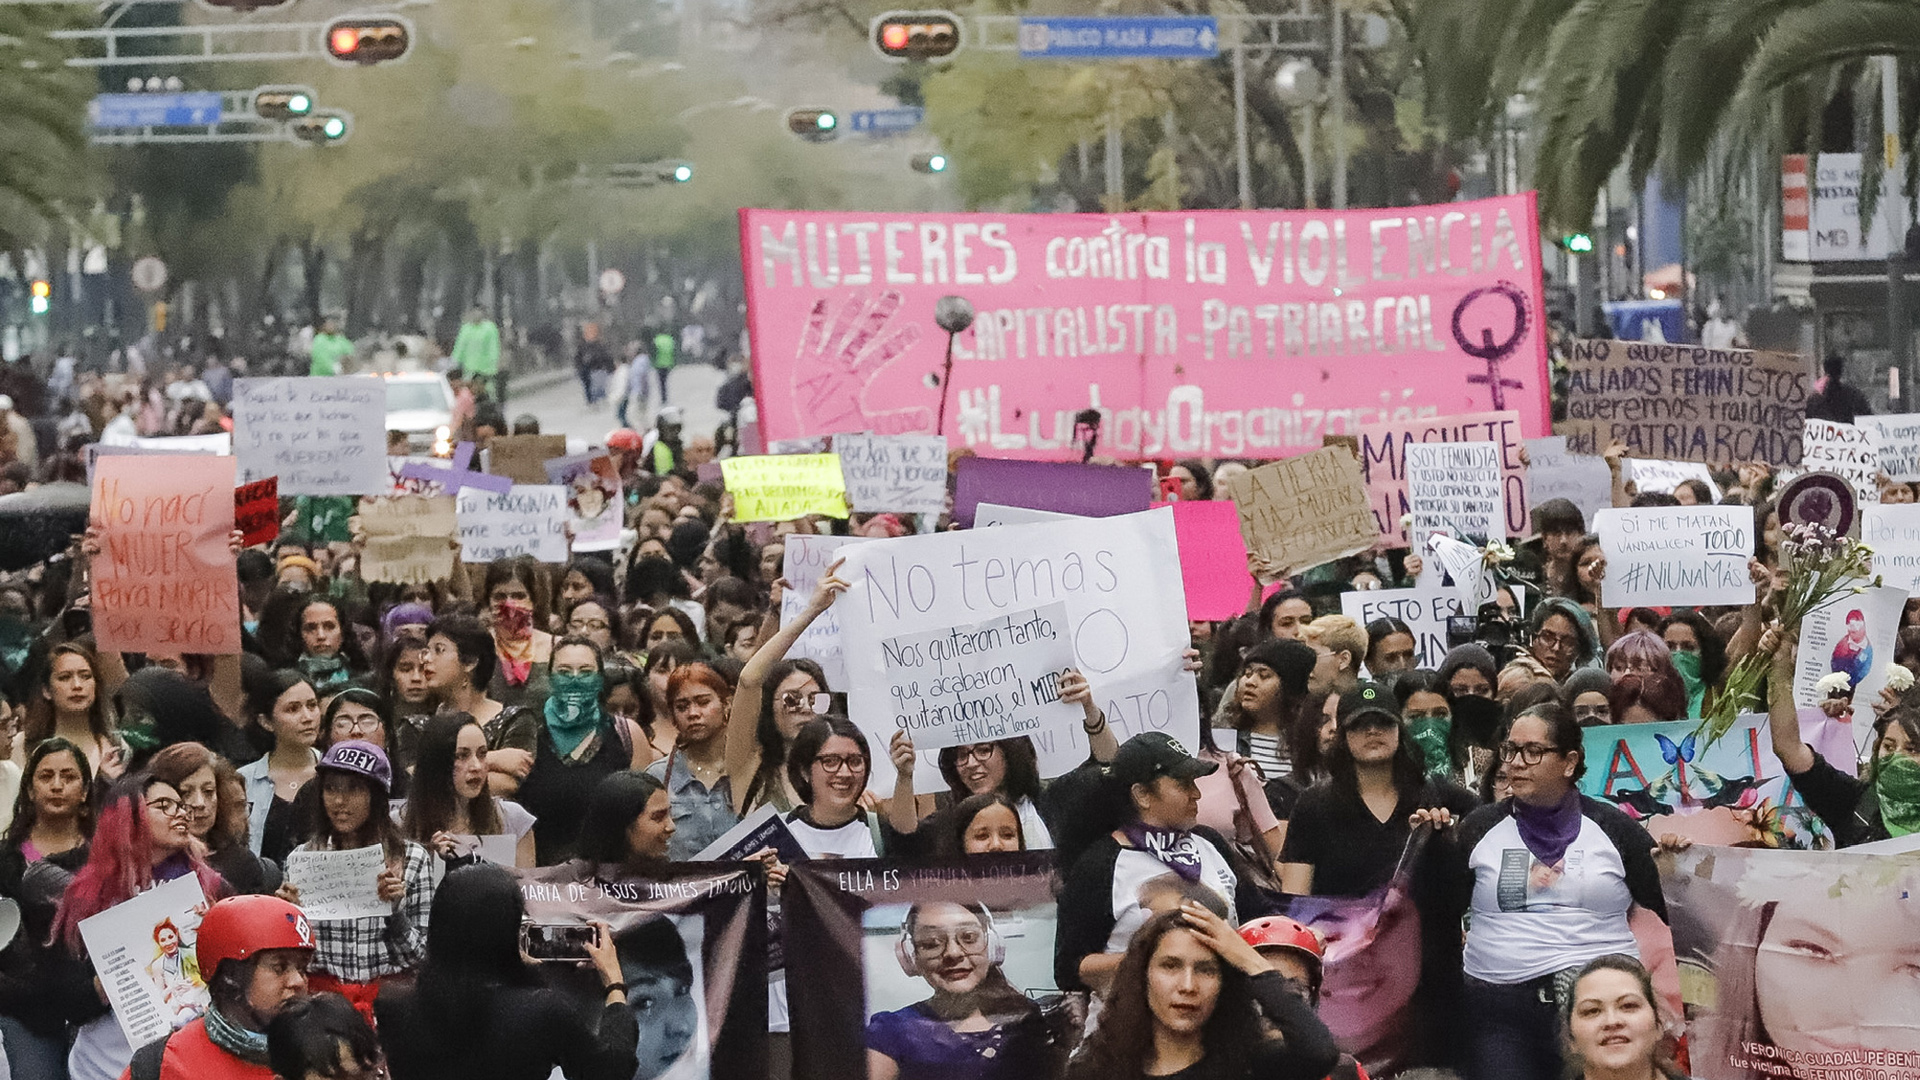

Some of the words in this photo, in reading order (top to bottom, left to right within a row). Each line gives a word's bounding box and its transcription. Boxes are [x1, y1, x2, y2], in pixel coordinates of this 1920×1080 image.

[761, 220, 1018, 289] MUJERES
[1045, 218, 1170, 281] contra
[1184, 218, 1228, 284] la
[1240, 208, 1524, 288] VIOLENCIA
[1574, 340, 1610, 362] NO
[1568, 366, 1662, 396] ALIADOS
[1671, 366, 1807, 404] FEMINISTOS
[1704, 399, 1807, 432] traidores
[1411, 446, 1437, 469] SOY
[1441, 446, 1499, 469] FEMINISTA
[1566, 425, 1597, 455] del
[1610, 422, 1804, 468] PATRIARCADO
[1802, 446, 1878, 468] UESTROS
[1420, 468, 1445, 482] USTED
[1447, 470, 1459, 482] NO
[1485, 486, 1500, 498] SIN
[1650, 517, 1669, 532] ME
[1700, 527, 1746, 550] TODO
[108, 531, 200, 582] MUJER
[952, 545, 1119, 612] temas
[1362, 597, 1422, 625] ESTO
[1431, 596, 1456, 623] ES
[881, 637, 924, 668] Nos
[928, 626, 1002, 677] quitaron
[1003, 609, 1058, 646] tanto,
[890, 681, 922, 710] que
[929, 662, 1017, 698] acabaron
[895, 692, 1004, 741] quitándonos
[1012, 678, 1027, 712] el
[335, 748, 376, 772] OBEY
[569, 884, 586, 903] DE
[648, 881, 699, 901] JAIMES
[838, 868, 875, 893] ELLA
[883, 868, 900, 892] ES
[1729, 1054, 1749, 1069] fue
[1792, 1064, 1807, 1079] de
